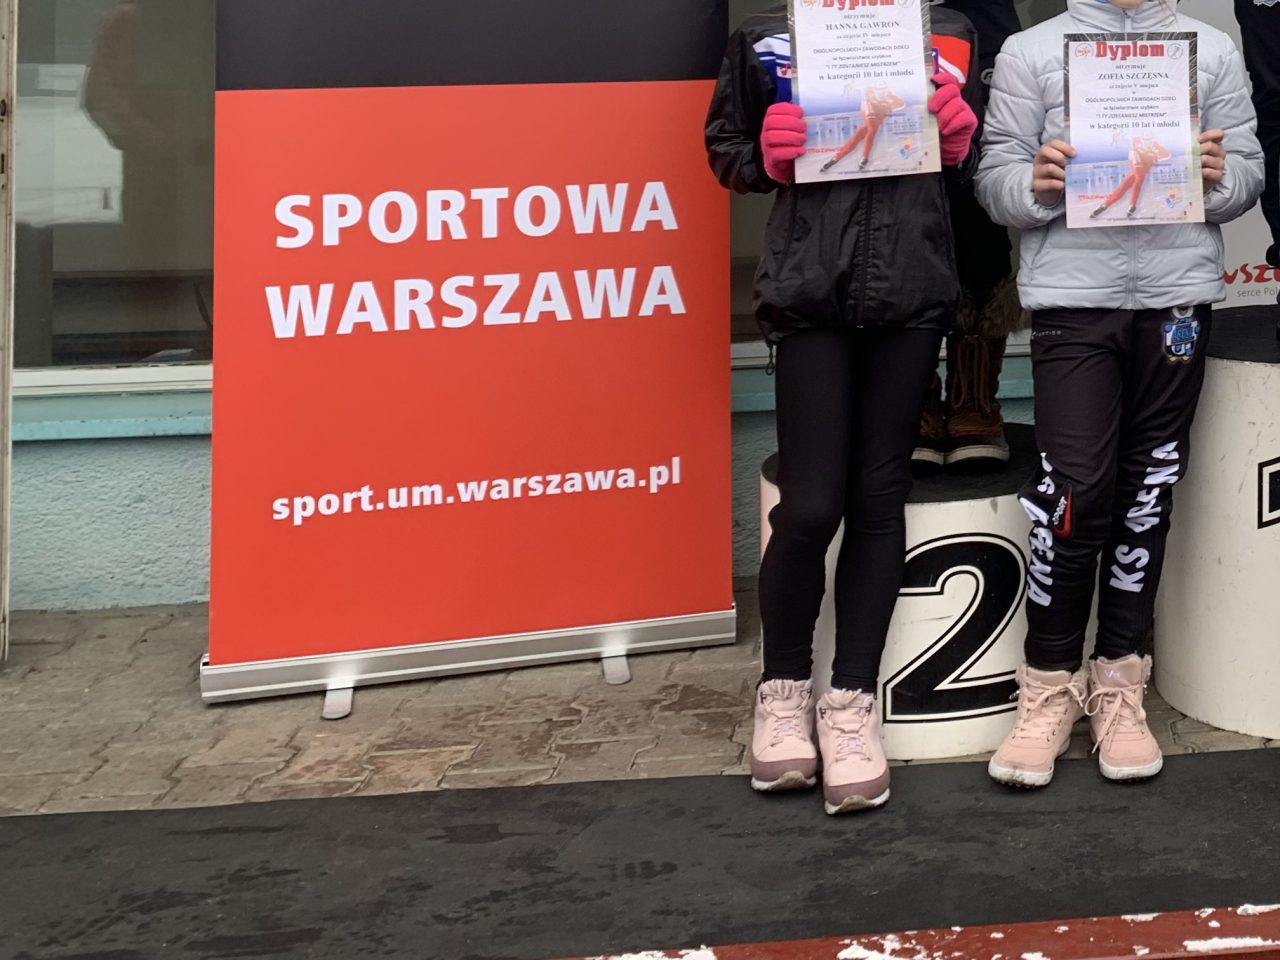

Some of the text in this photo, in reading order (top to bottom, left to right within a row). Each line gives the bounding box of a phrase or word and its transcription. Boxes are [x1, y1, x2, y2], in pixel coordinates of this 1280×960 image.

[860, 21, 900, 29] GAWRON
[1096, 39, 1164, 60] Dyplom
[890, 69, 914, 77] młodsi
[274, 181, 678, 248] SPORTOWA
[264, 265, 686, 338] WARSZAWA
[1237, 286, 1279, 298] serce Pol
[272, 457, 681, 526] sport.um.warszawa.pl
[1109, 441, 1180, 593] KS ARENA
[883, 532, 1030, 724] 2
